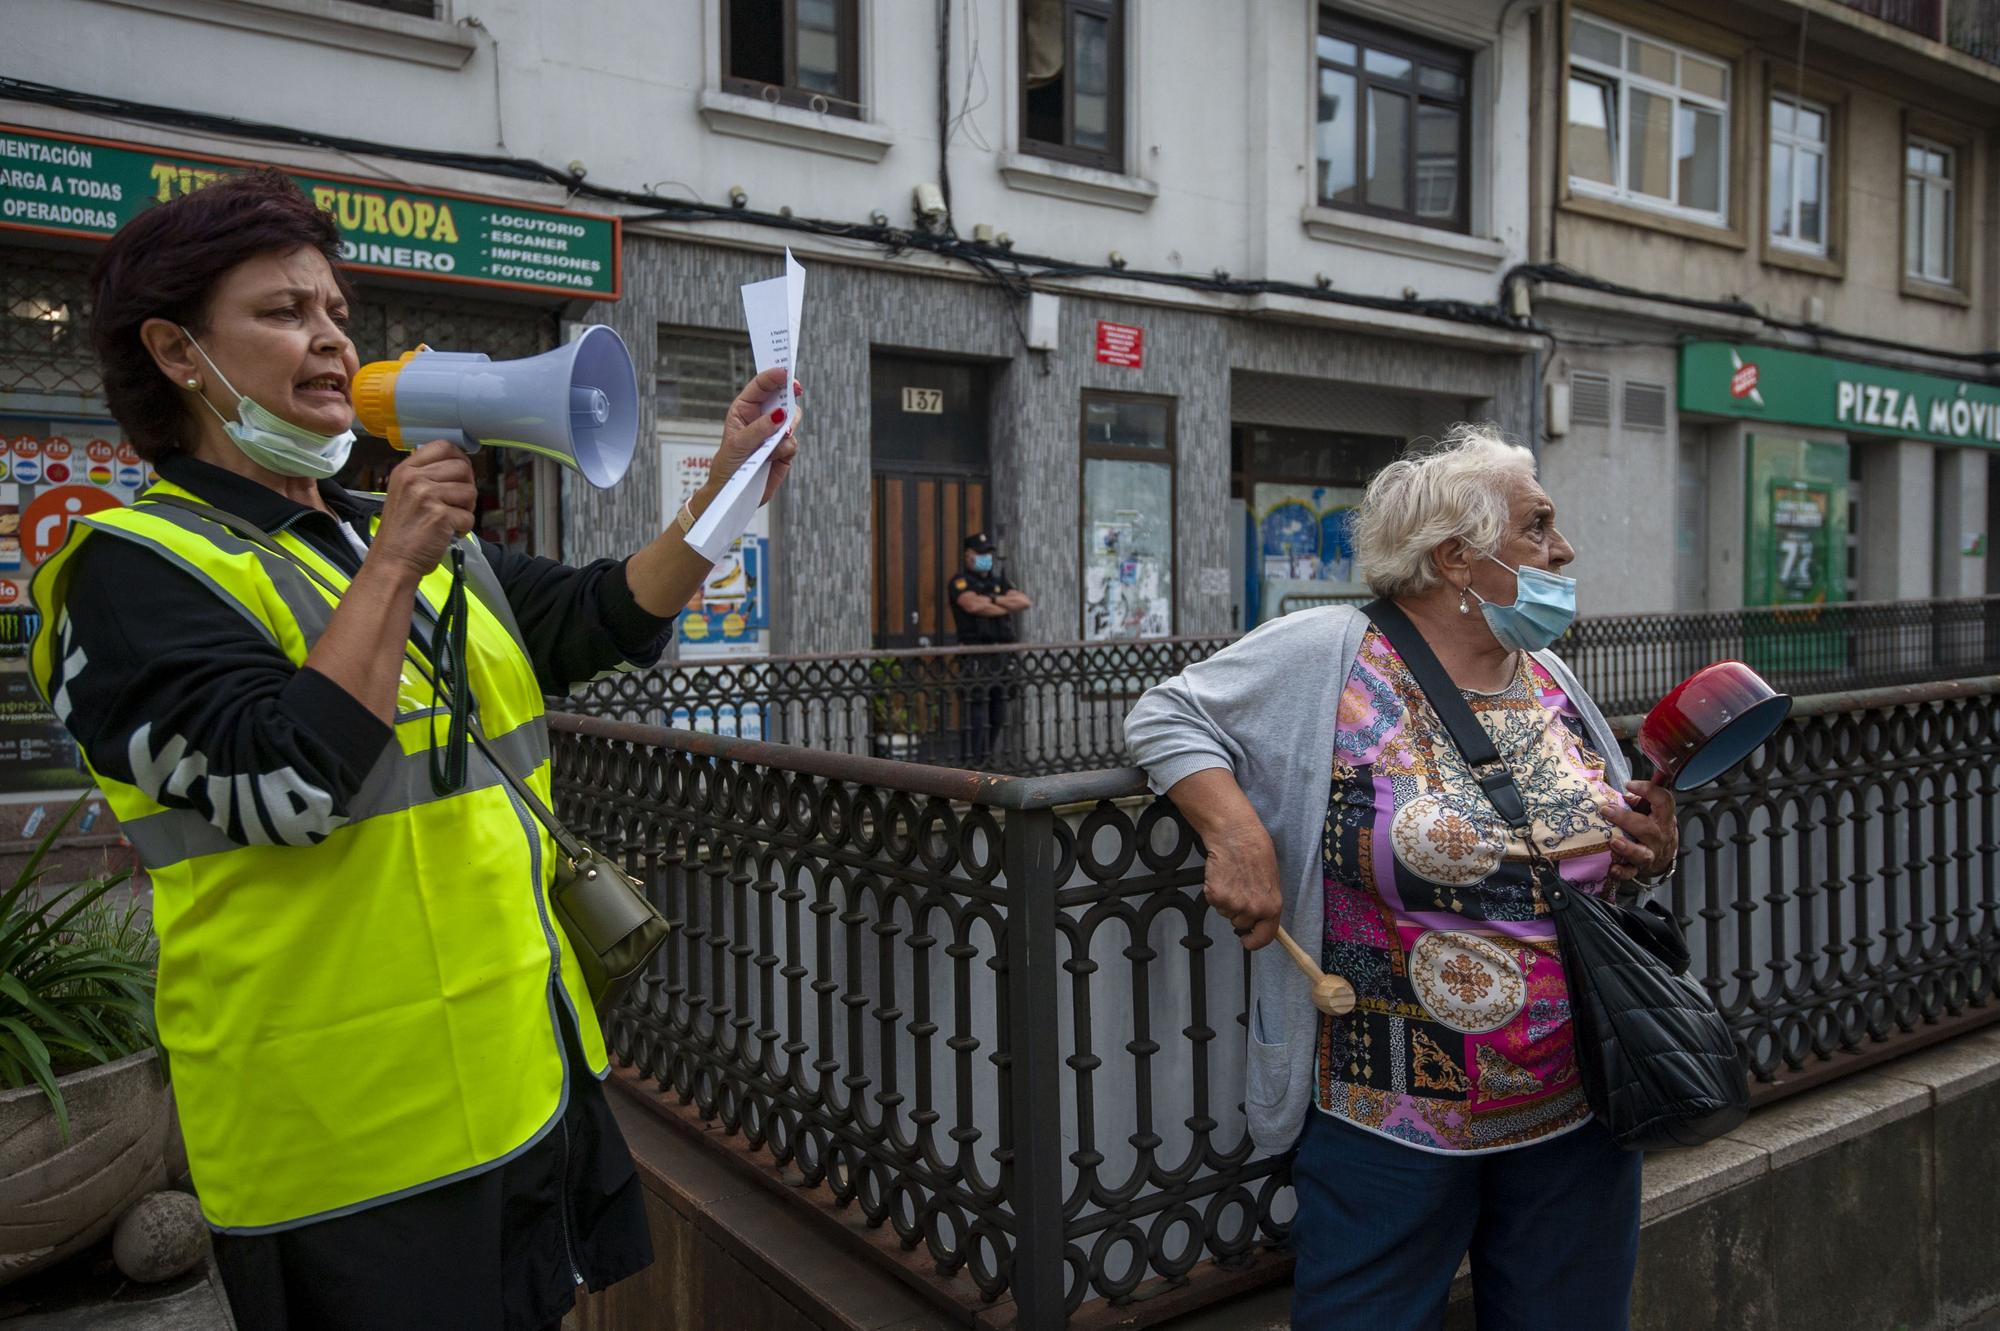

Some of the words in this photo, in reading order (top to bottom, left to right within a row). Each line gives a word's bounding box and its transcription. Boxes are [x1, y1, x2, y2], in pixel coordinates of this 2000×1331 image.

[51, 175, 64, 193] A
[67, 177, 122, 201] TODAS
[3, 198, 117, 229] OPERADORAS
[312, 186, 459, 244] EUROPA
[490, 213, 586, 238] LOCUTORIO
[490, 229, 568, 252] ESCANER
[340, 240, 455, 273] DINERO
[490, 246, 601, 273] IMPRESIONES
[490, 263, 594, 288] FOTOCOPIAS
[906, 388, 941, 411] 137
[1838, 380, 1921, 432] PIZZA
